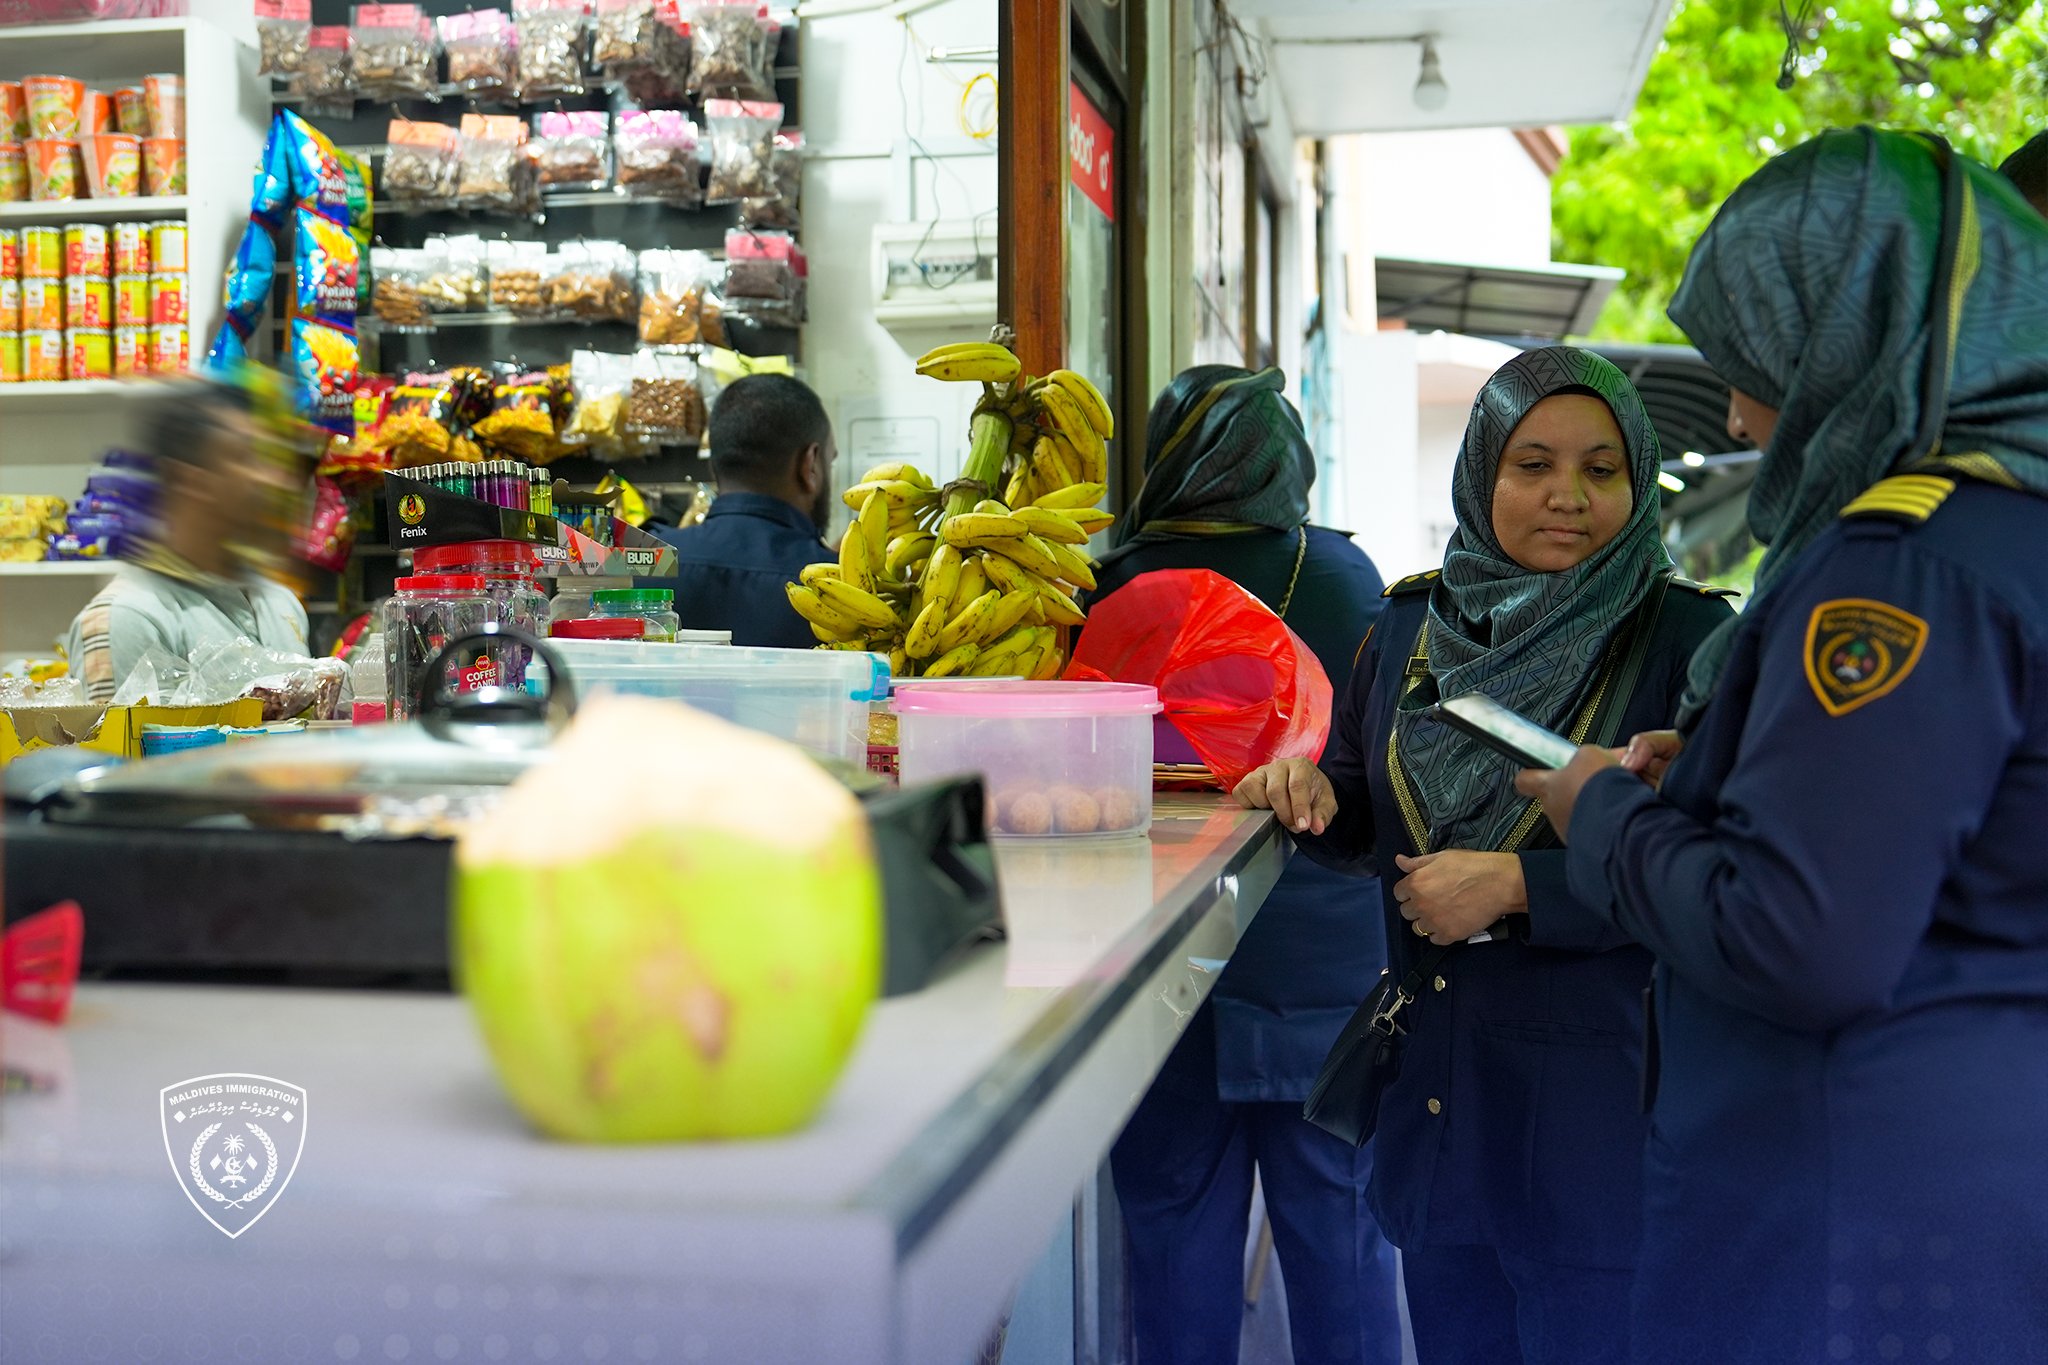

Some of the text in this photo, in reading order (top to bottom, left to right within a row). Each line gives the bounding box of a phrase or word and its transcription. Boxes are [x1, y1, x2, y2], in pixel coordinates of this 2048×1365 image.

[401, 525, 428, 539] Fenix
[627, 551, 654, 565] BURJ
[466, 667, 497, 683] COFFEE
